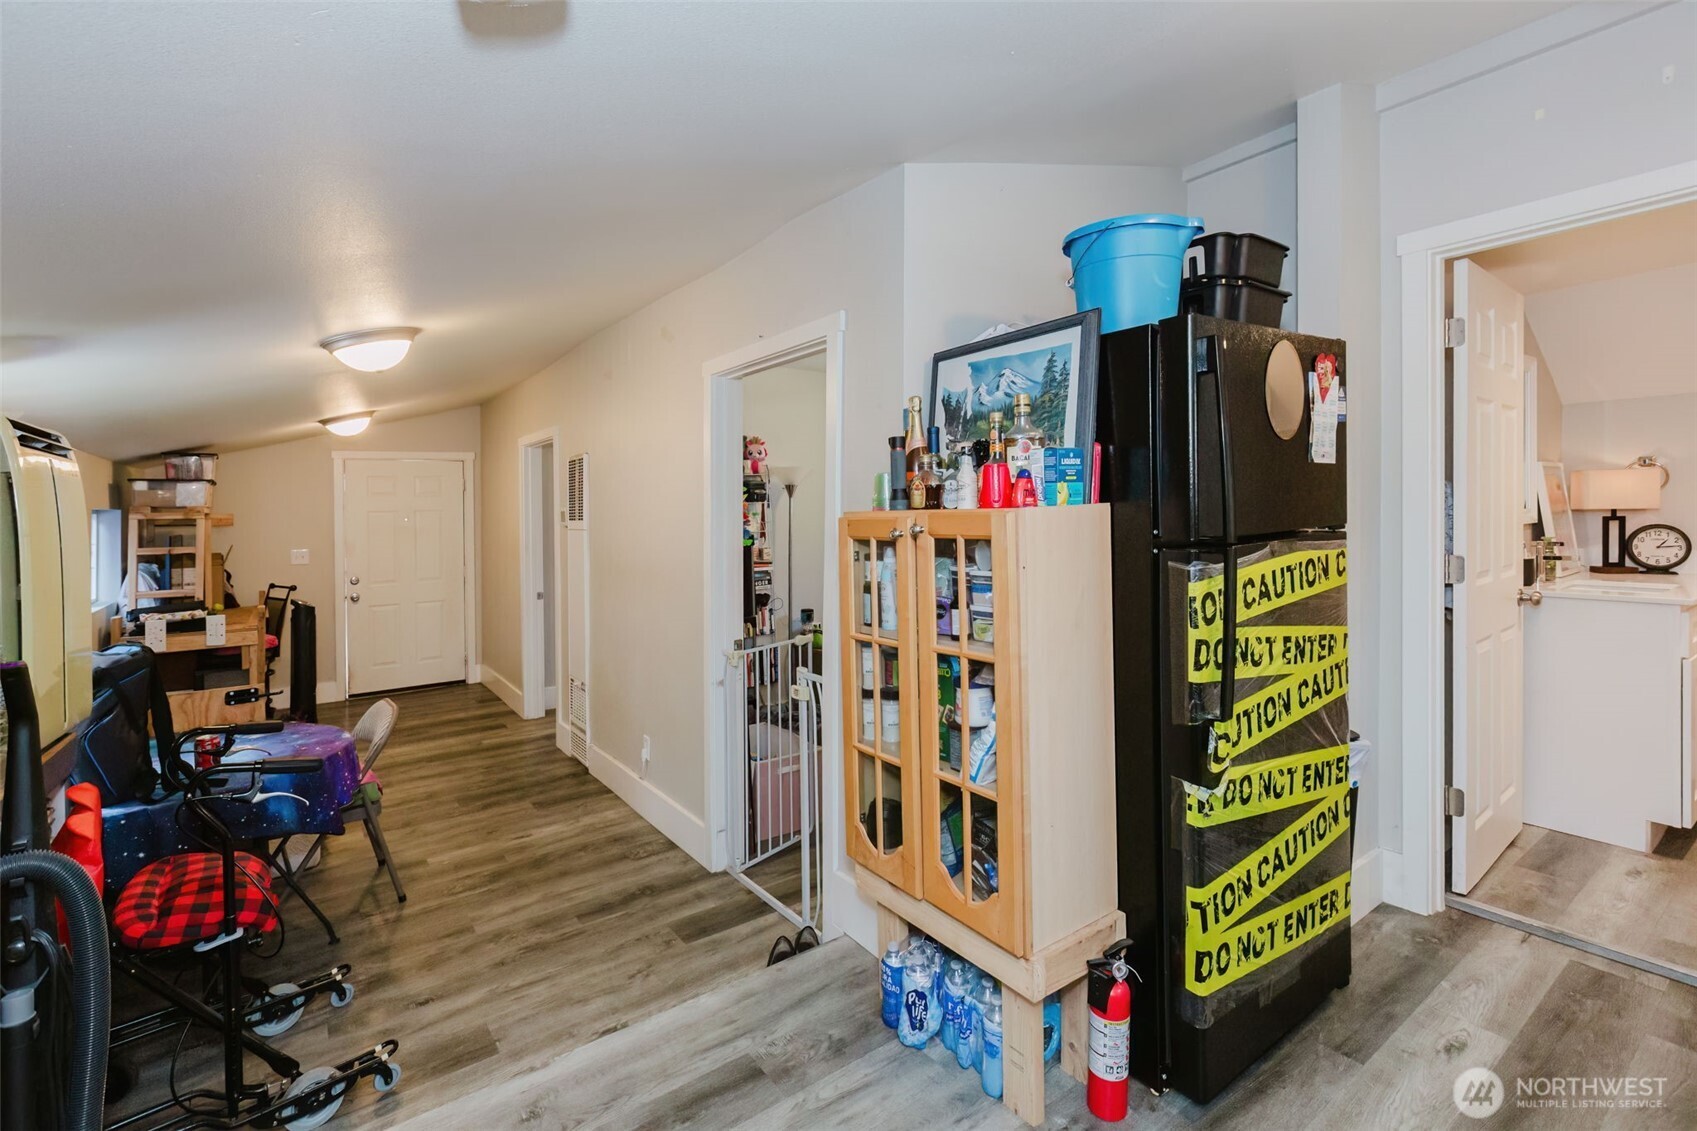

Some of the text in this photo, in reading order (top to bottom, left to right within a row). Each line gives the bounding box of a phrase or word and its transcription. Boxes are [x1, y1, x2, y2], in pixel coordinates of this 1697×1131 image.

[1241, 553, 1330, 610] CAUTION
[1192, 638, 1224, 672] DO
[1234, 635, 1278, 668] NOT
[1281, 631, 1337, 666] ENTER
[1222, 774, 1253, 810] DO
[1258, 765, 1298, 803] NOT
[1257, 800, 1340, 888] CAUTION
[1194, 941, 1231, 984] DO
[1236, 918, 1279, 967] NOT
[1283, 889, 1339, 945] ENTER
[911, 1004, 928, 1023] life
